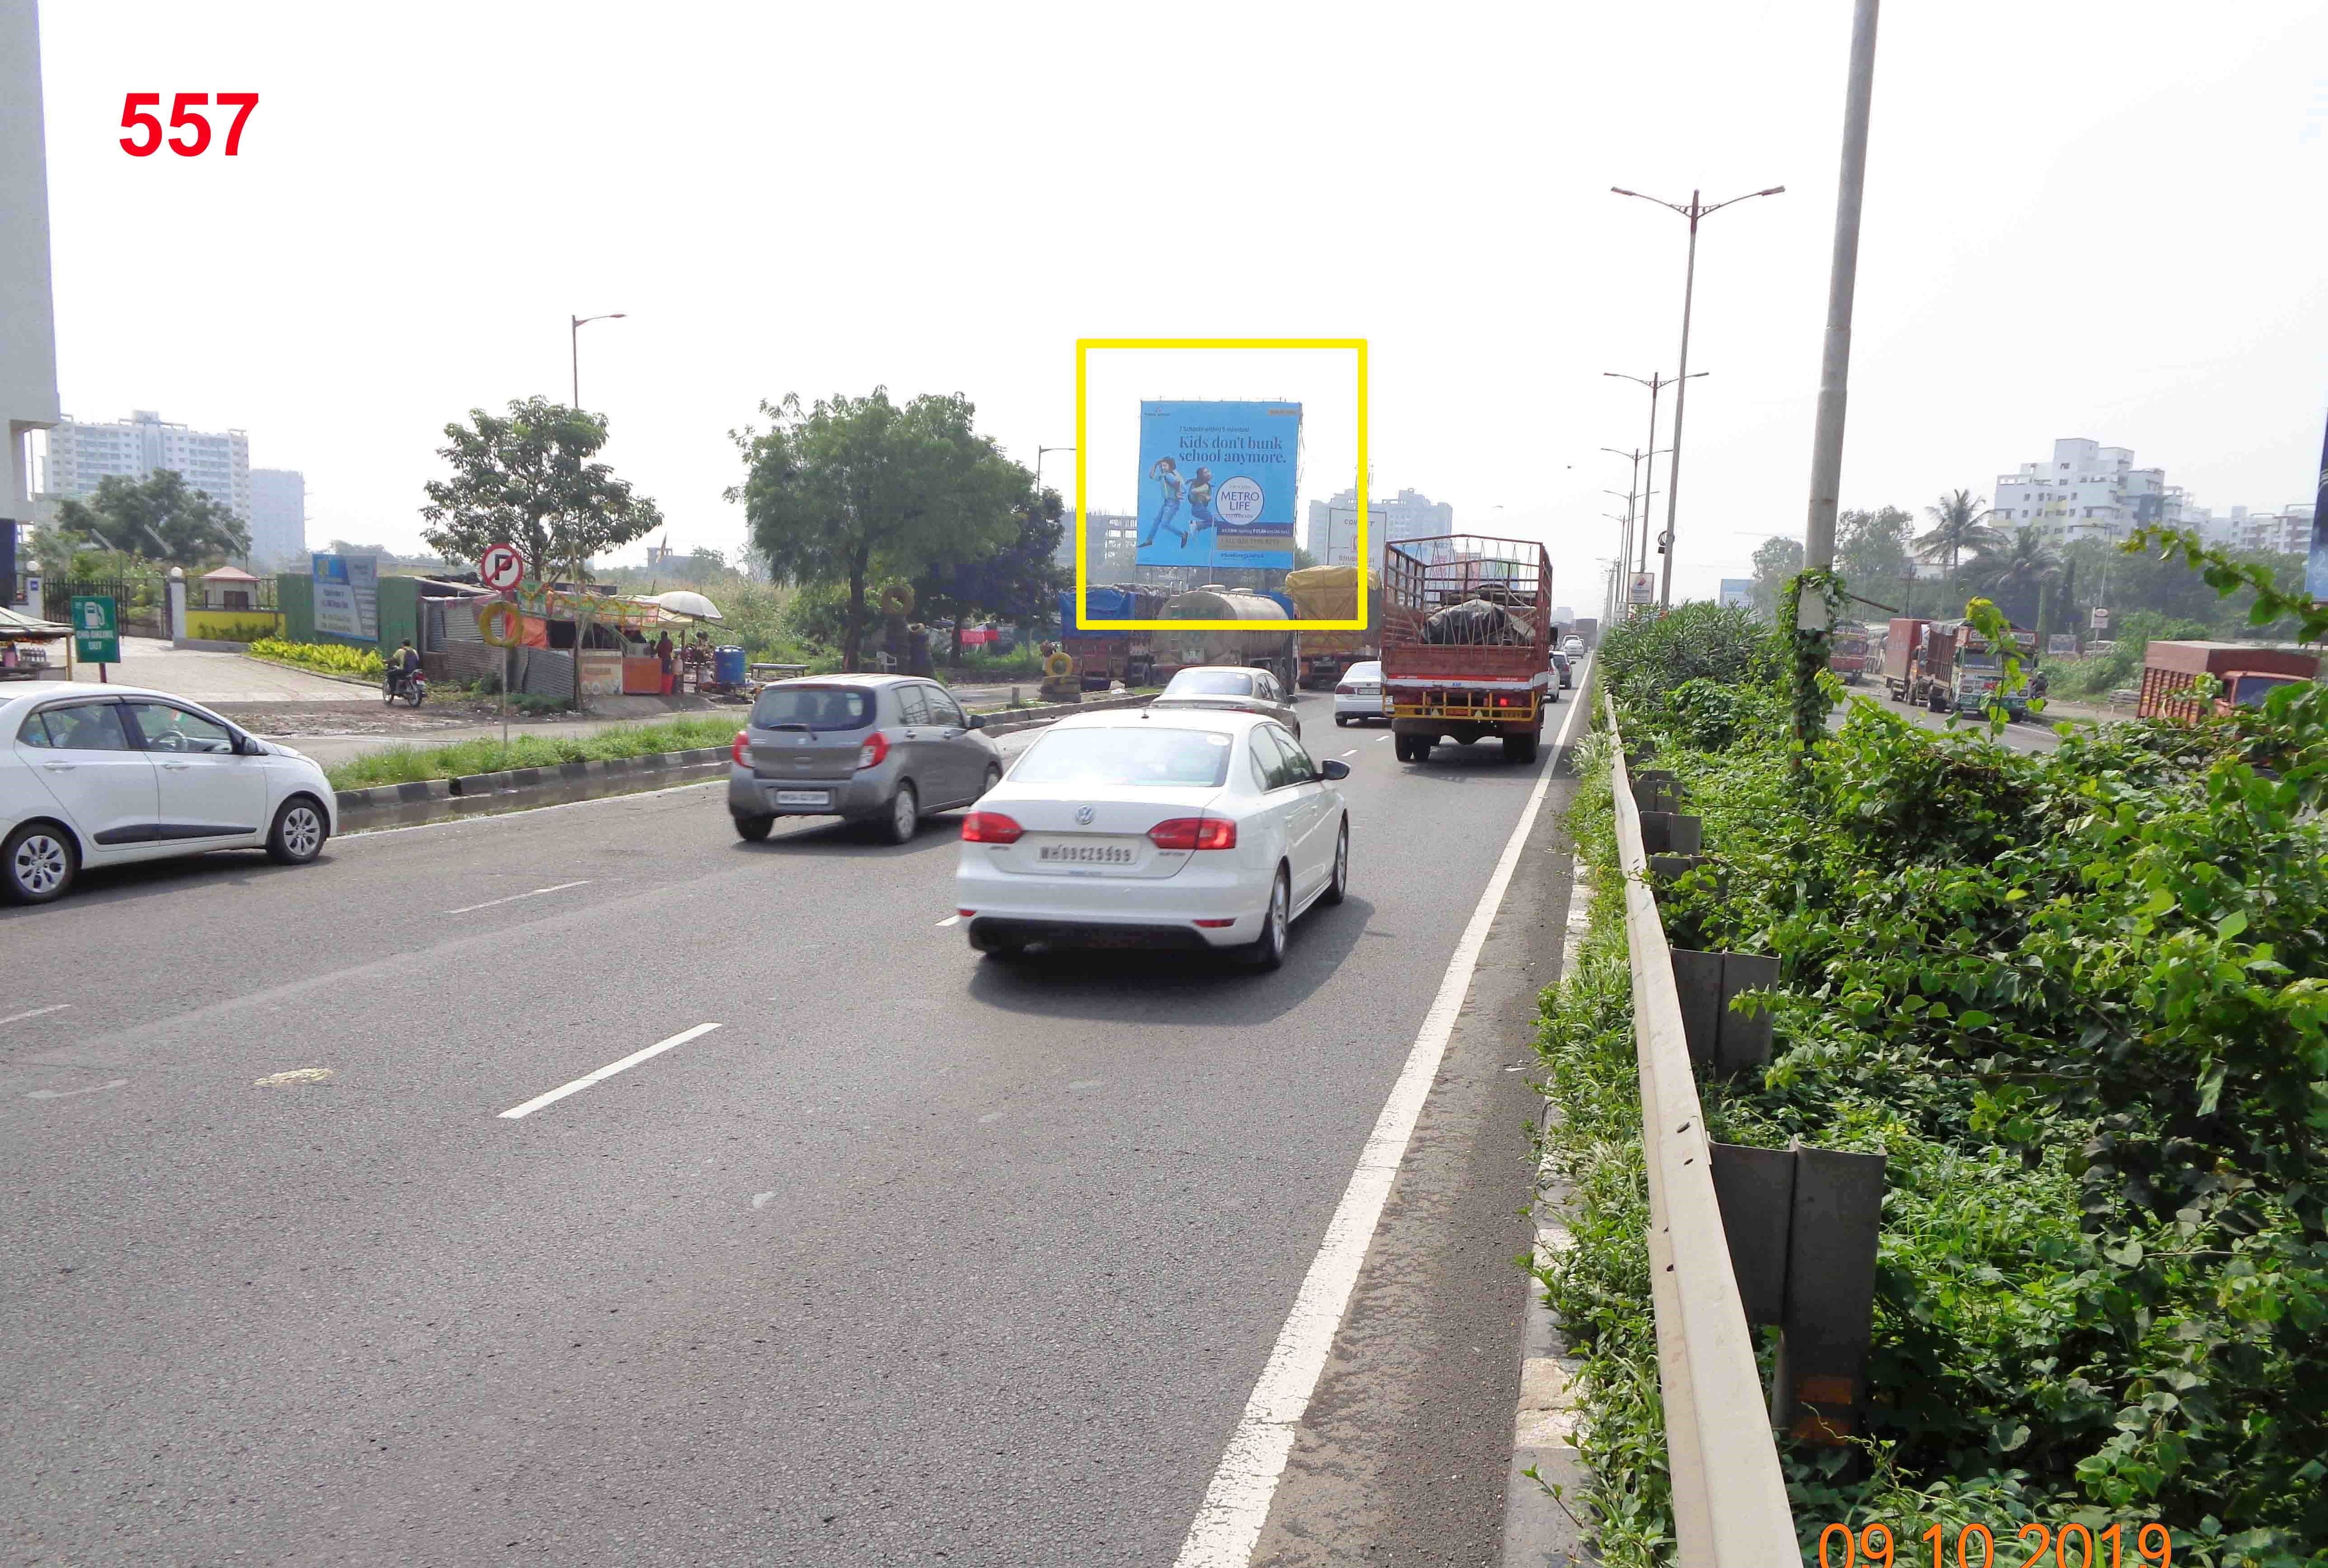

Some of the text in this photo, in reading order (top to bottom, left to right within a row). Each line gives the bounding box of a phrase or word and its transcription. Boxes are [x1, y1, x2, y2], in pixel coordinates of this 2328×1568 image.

[1179, 436, 1283, 449] Kids don't bunk
[1178, 449, 1287, 465] school anymore.
[1221, 491, 1260, 501] METRO
[1230, 501, 1251, 510] LIFE
